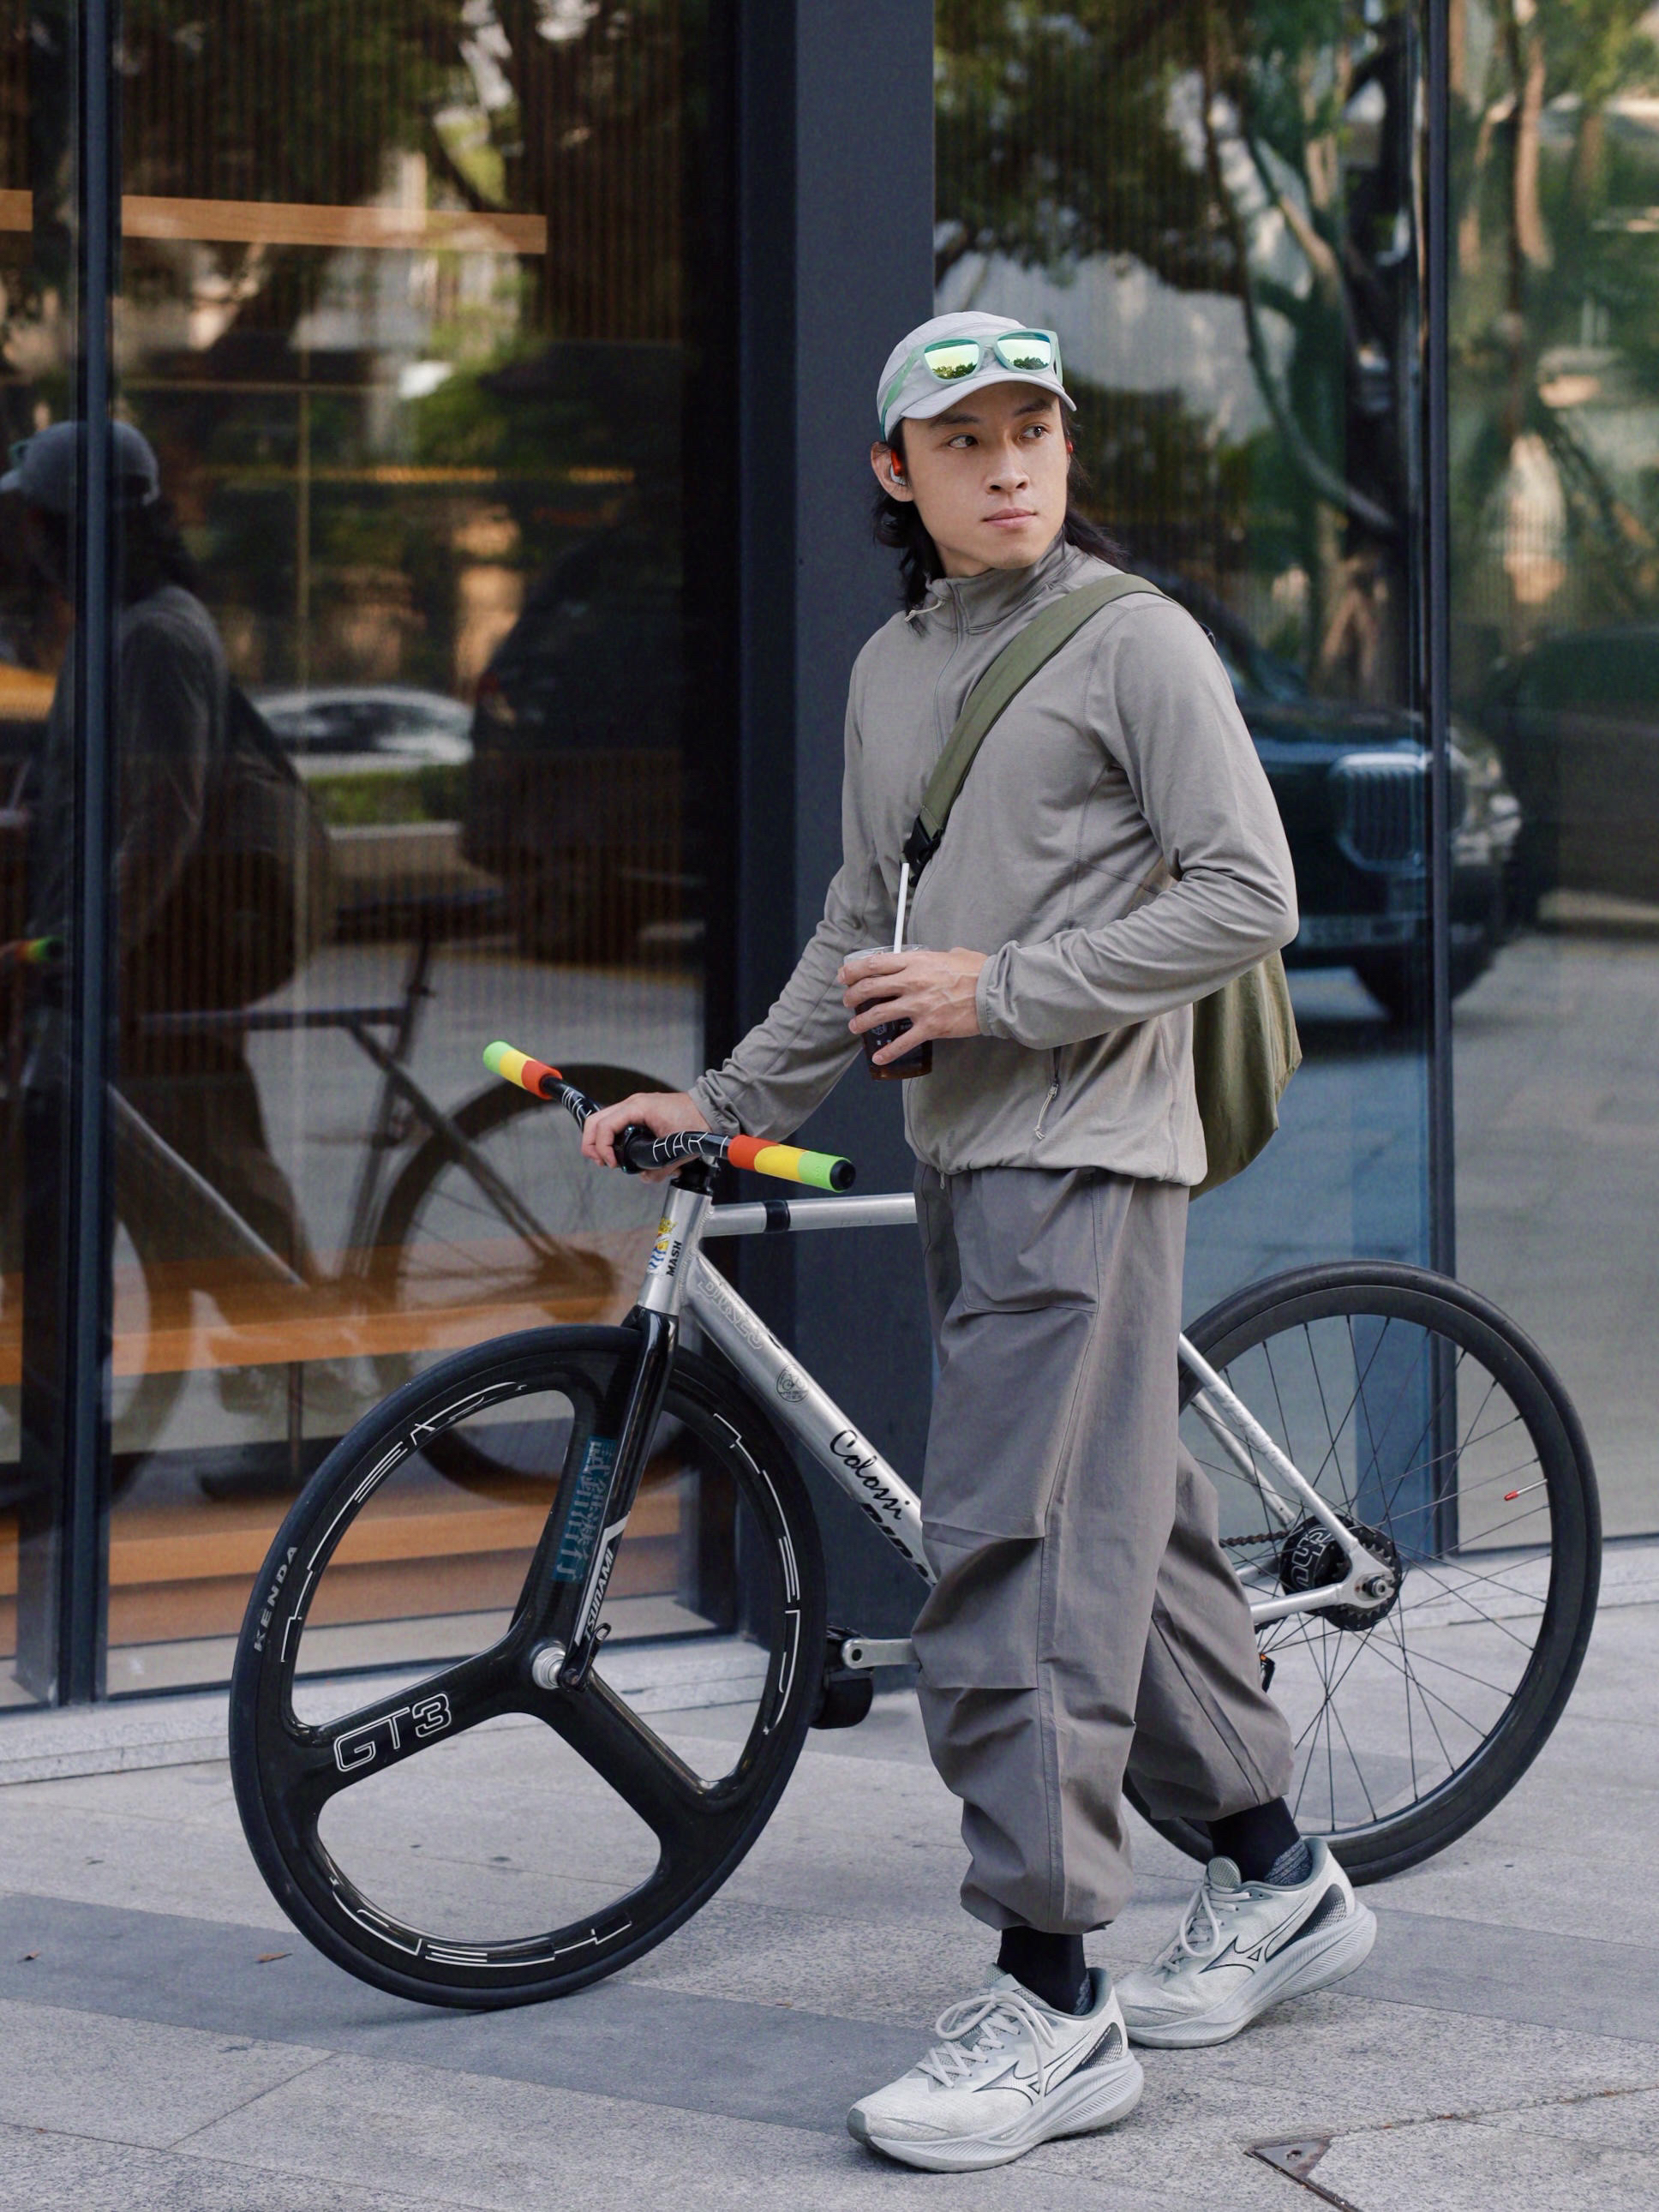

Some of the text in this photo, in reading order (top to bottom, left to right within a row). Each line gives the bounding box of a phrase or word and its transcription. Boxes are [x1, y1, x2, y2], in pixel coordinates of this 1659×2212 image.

[666, 1240, 682, 1277] MASH
[829, 1429, 911, 1520] Colossi
[254, 1547, 297, 1652] KENDA
[584, 1547, 614, 1641] TSUNAMI
[333, 1693, 452, 1772] GT3
